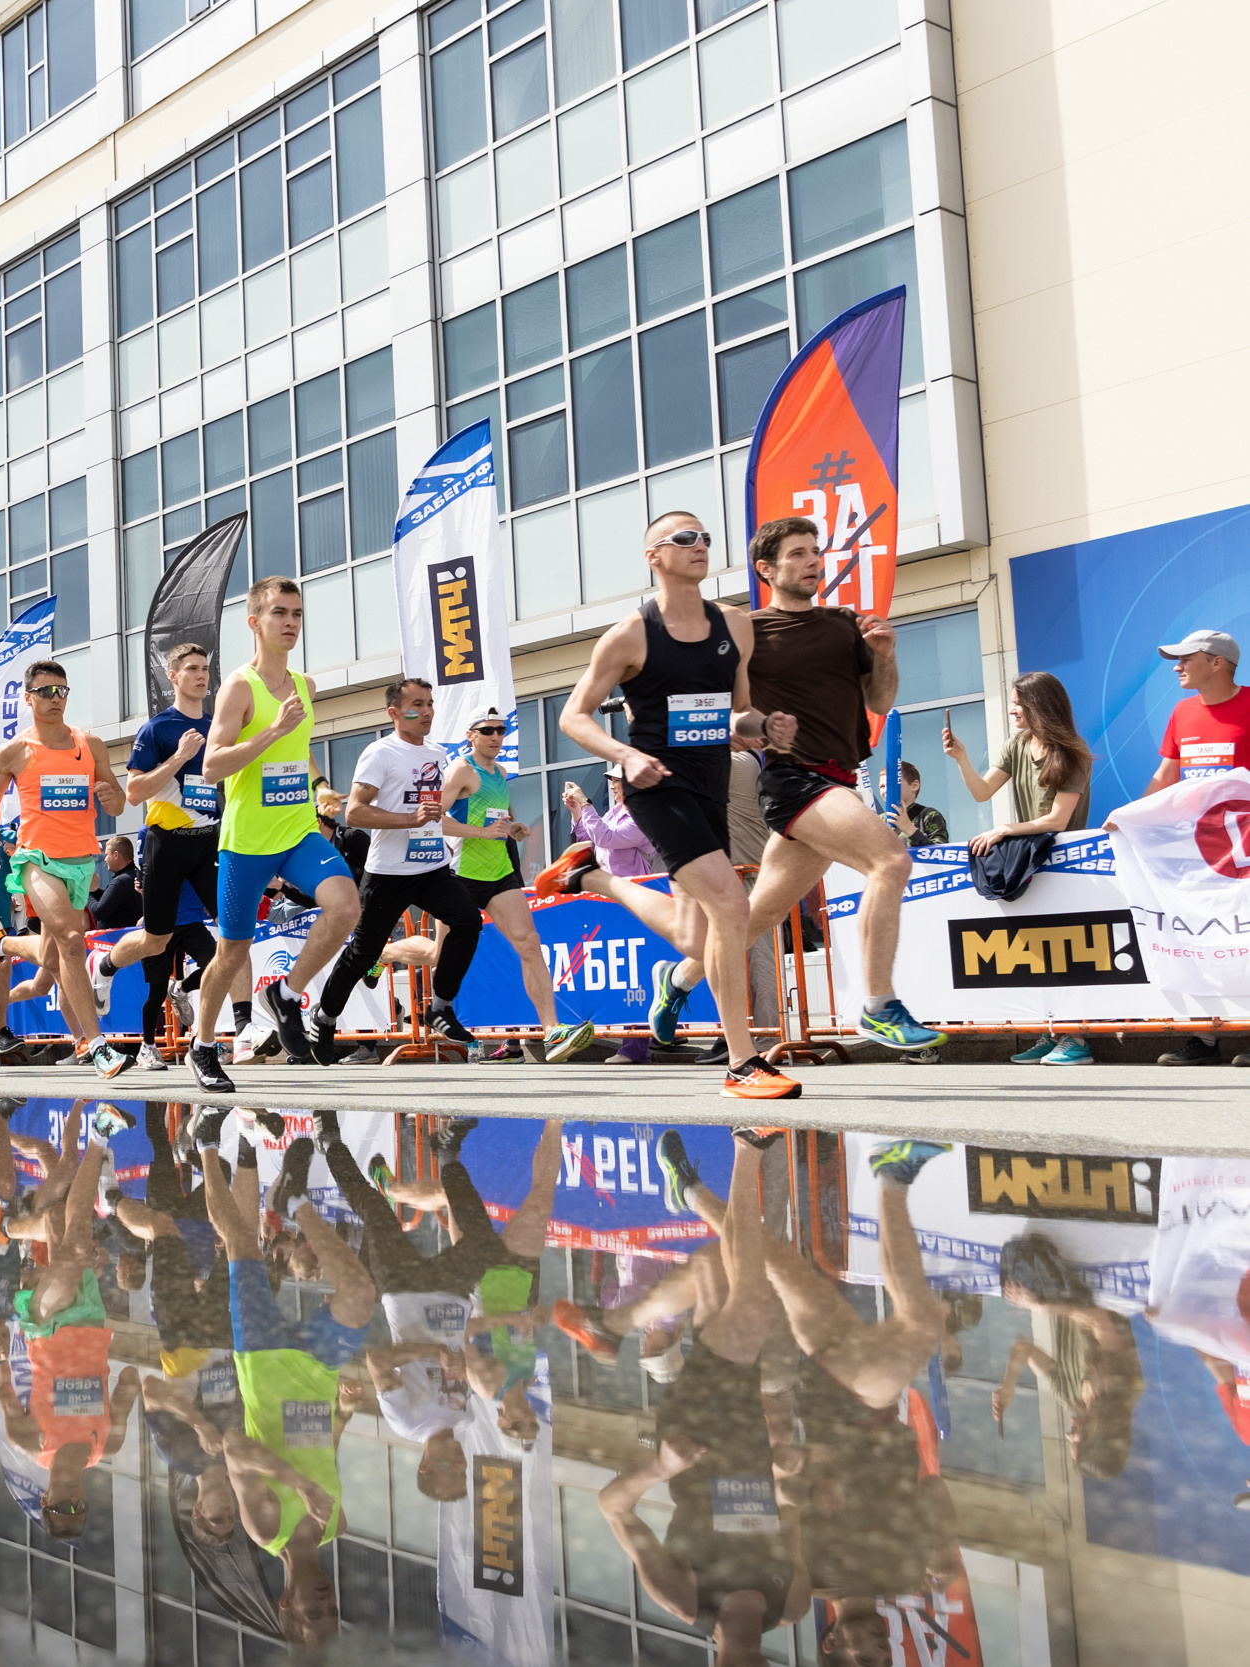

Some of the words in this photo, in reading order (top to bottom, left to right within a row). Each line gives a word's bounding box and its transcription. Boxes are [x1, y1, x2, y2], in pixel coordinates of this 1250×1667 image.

[411, 462, 491, 524] ЗАБЕГ.РФ
[812, 545, 887, 611] ЕГ
[437, 567, 475, 677] МАТЧ!
[2, 680, 23, 741] AER
[674, 728, 727, 742] 50198
[43, 799, 87, 808] 50394
[265, 790, 308, 802] 50039
[172, 828, 197, 836] NIKE
[197, 826, 213, 835] PRO
[409, 851, 443, 860] 50722
[269, 913, 317, 936] ЗАБЕГ.РФ
[961, 922, 1135, 977] МАТЧ!
[1152, 943, 1205, 960] ВМЕСТЕ
